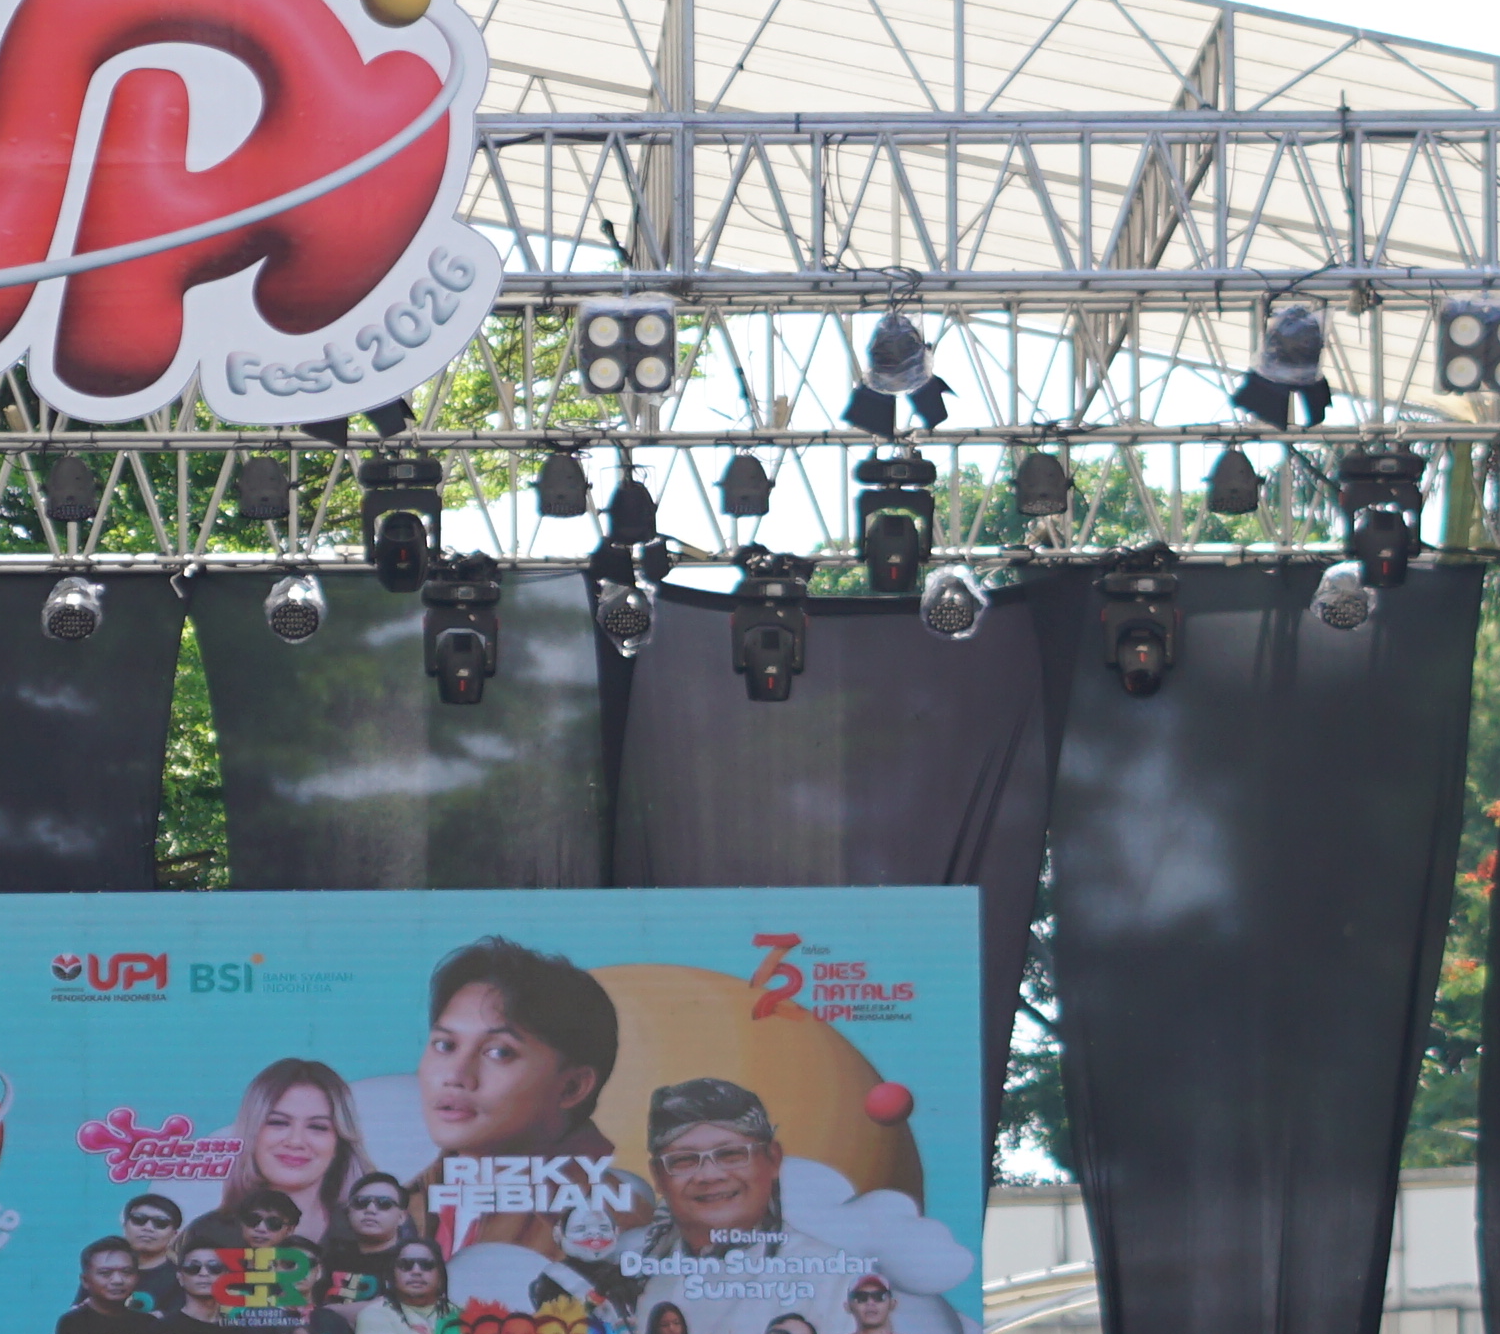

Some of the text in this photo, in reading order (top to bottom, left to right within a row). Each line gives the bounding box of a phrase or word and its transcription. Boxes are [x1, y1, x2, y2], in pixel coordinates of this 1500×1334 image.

[225, 244, 477, 398] Fest 2026
[189, 962, 253, 994] BSI
[263, 972, 297, 982] BANK
[813, 962, 867, 981] DIES
[113, 993, 168, 1002] INDONESIA
[263, 982, 333, 994] INDONESIA
[813, 982, 915, 1001] NATALIS
[813, 1004, 852, 1022] UPI
[130, 1137, 195, 1160] Ade
[131, 1156, 235, 1180] Astrid
[443, 1156, 615, 1185] RIZKY
[427, 1183, 632, 1213] FEBIAN
[710, 1229, 788, 1245] Ki Dalang
[620, 1249, 879, 1277] Dadan Sunandar
[683, 1275, 815, 1306] Sunarya
